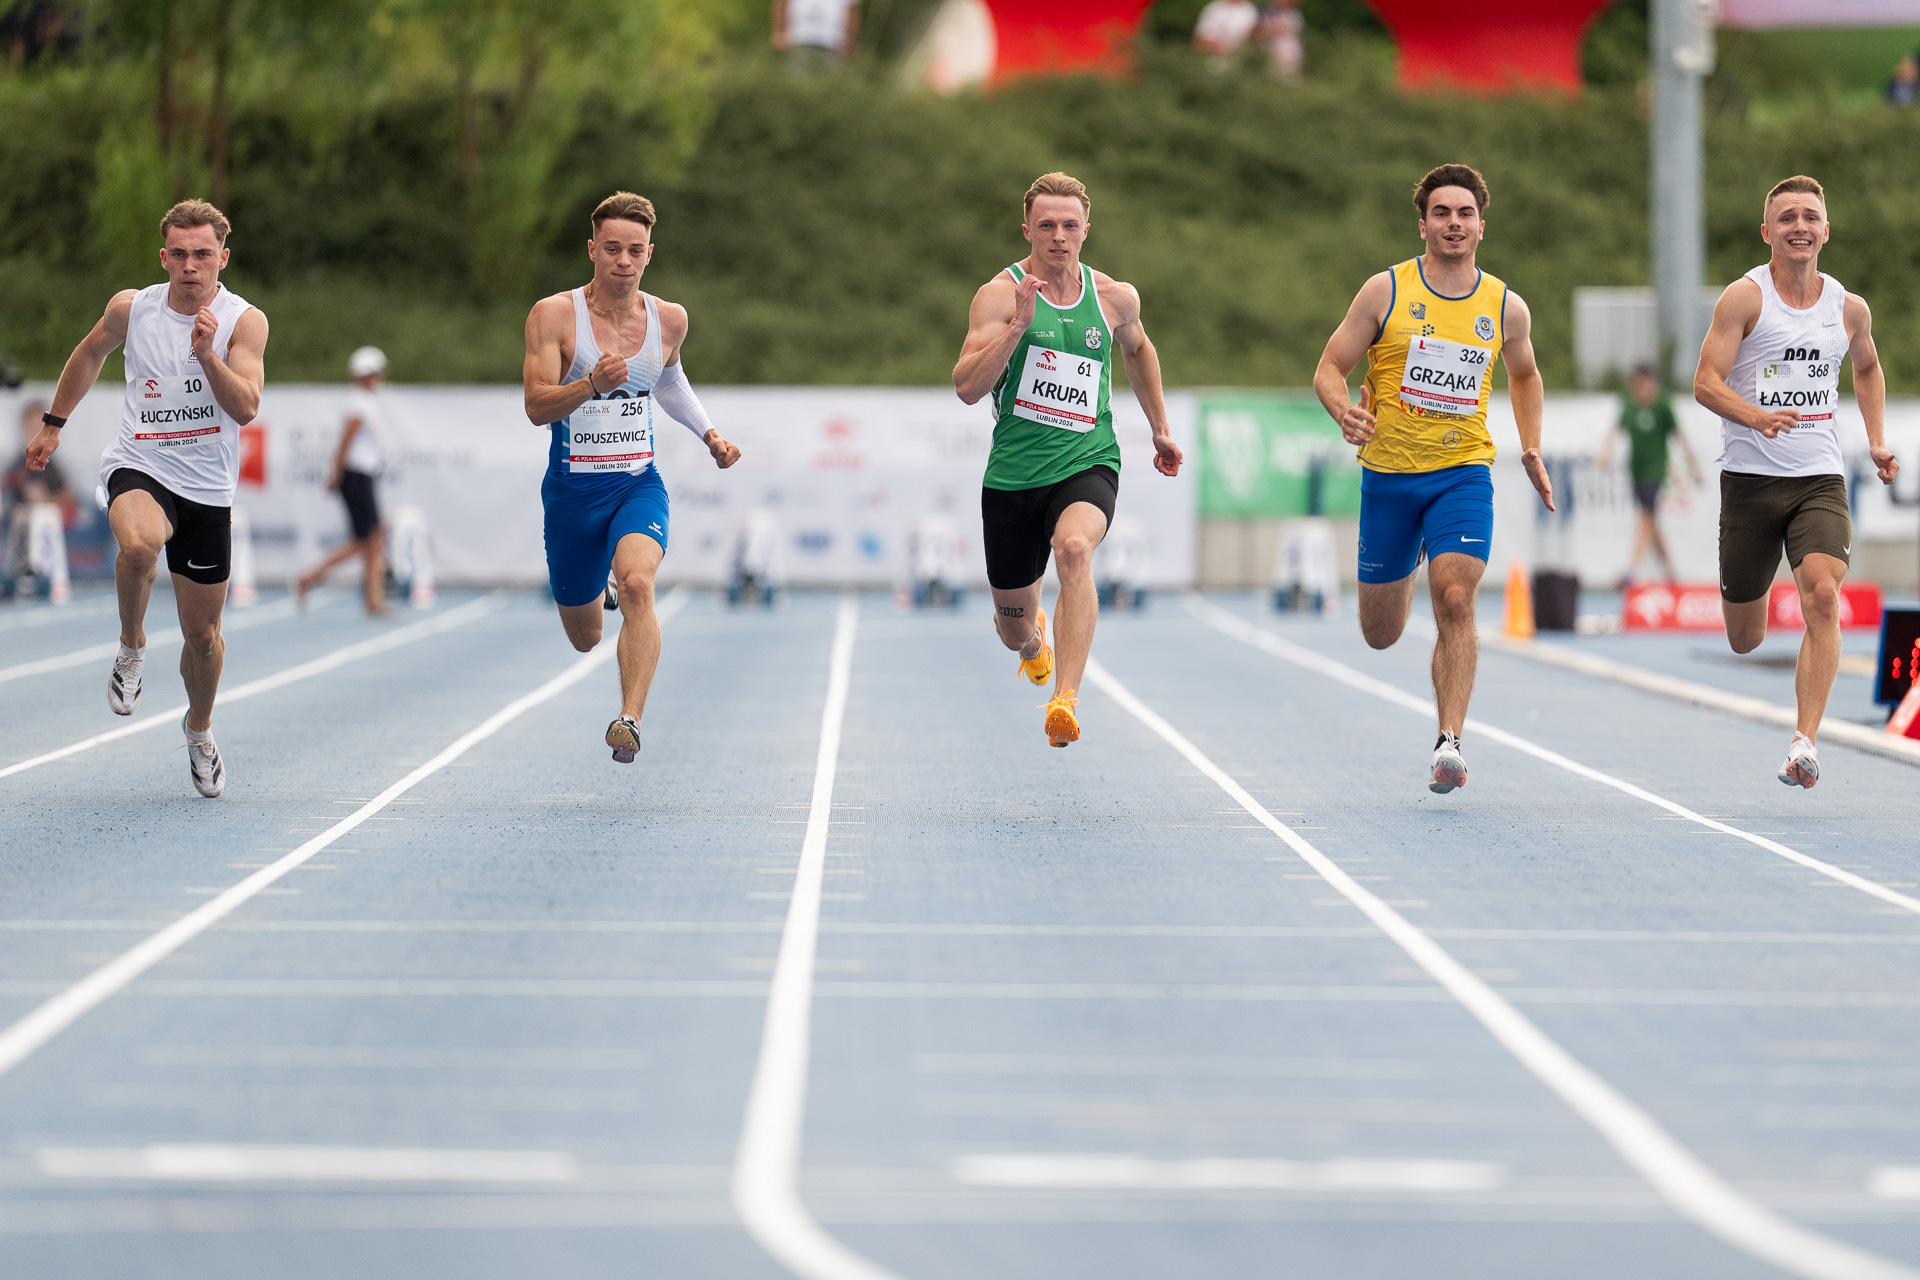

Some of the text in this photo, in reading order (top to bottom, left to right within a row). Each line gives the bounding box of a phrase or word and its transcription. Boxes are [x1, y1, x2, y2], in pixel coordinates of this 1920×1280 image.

[1460, 349, 1484, 364] 326
[1036, 362, 1056, 372] ORLEN
[1078, 362, 1091, 377] 61
[1808, 364, 1829, 378] 368
[184, 379, 202, 394] 10
[1410, 366, 1476, 392] GRZĄKA
[1032, 379, 1088, 407] KRUPA
[1422, 392, 1453, 402] MISTRZOSTWA
[1759, 390, 1829, 406] ŁAZOWY
[621, 401, 643, 416] 256
[1421, 400, 1442, 408] LUBLIN
[140, 405, 214, 423] ŁUCZYŃSKI
[1036, 414, 1073, 427] LUBLIN 2024
[1037, 405, 1069, 418] MISTRZOSTWA
[1070, 413, 1084, 422] POLSKI
[574, 430, 646, 444] OPUSZEWICZ
[998, 604, 1024, 618] 2002
